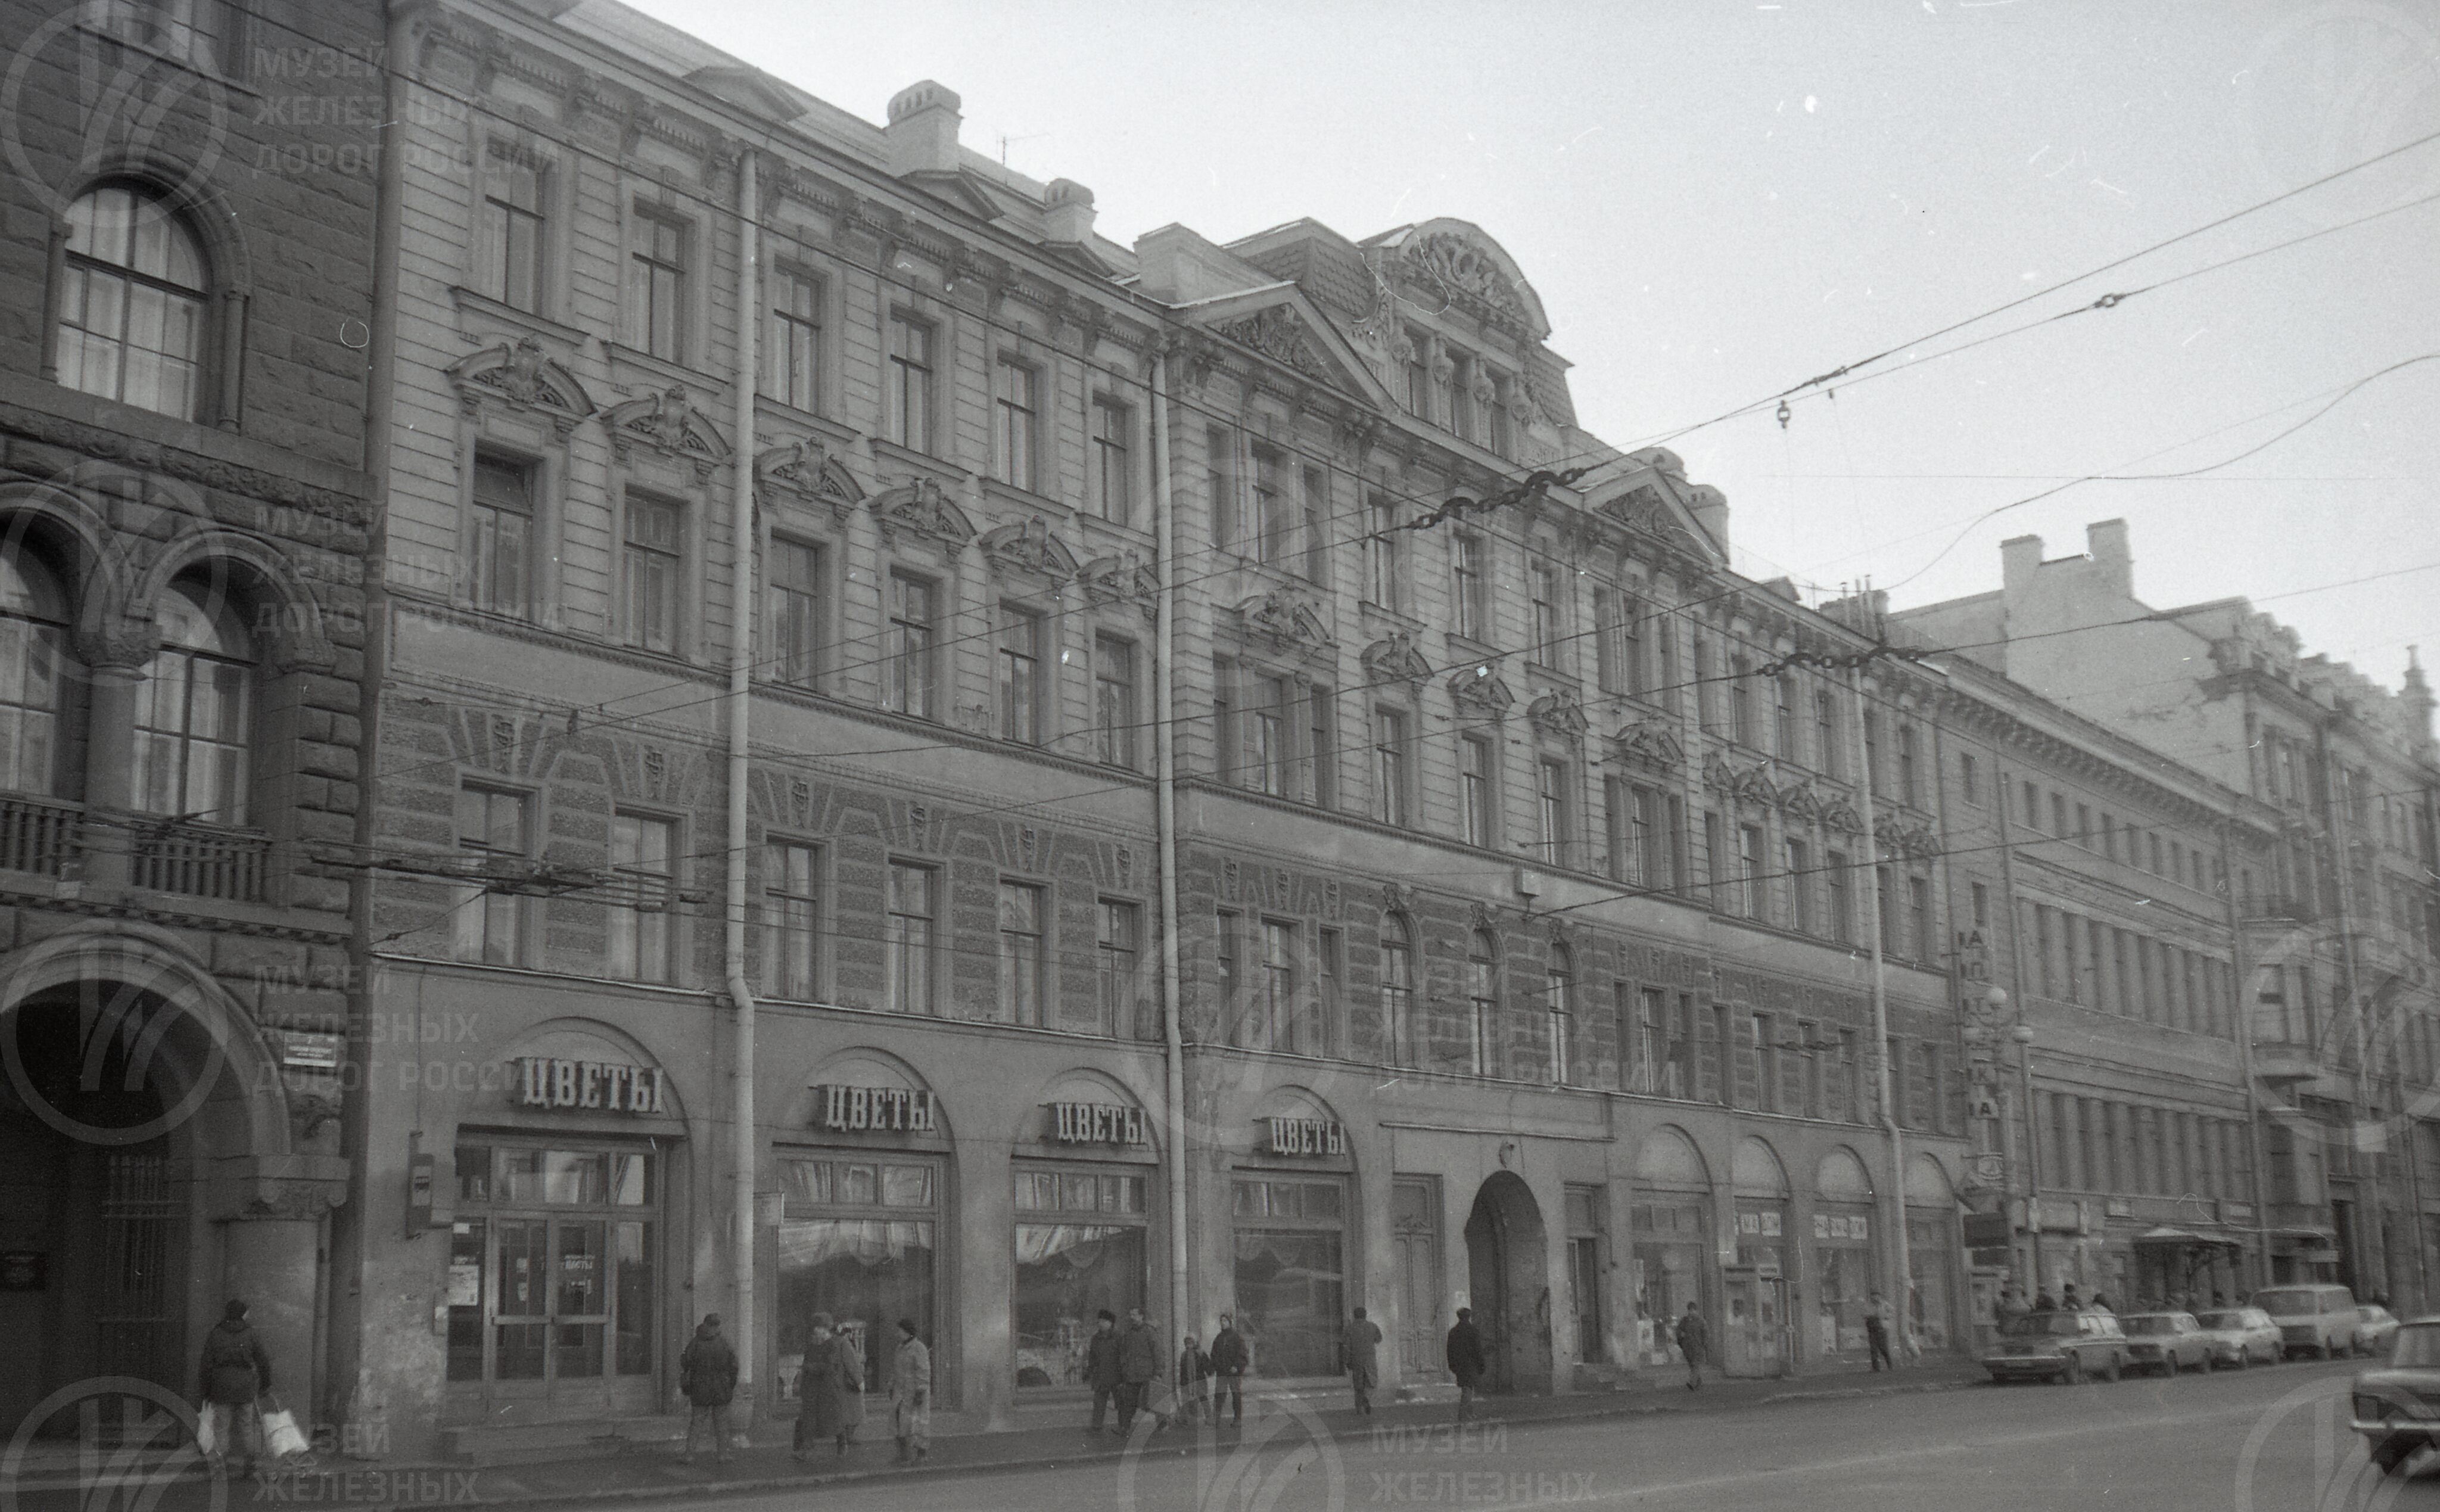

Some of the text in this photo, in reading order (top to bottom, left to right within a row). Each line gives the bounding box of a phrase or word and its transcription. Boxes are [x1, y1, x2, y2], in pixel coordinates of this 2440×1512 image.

[523, 1057, 664, 1112] ЦВЕТЫ
[826, 1085, 935, 1132] ЦВЕТЫ
[1056, 1103, 1149, 1144] ЦВЕТЫ
[1271, 1116, 1346, 1155] ЦВЕТЫ
